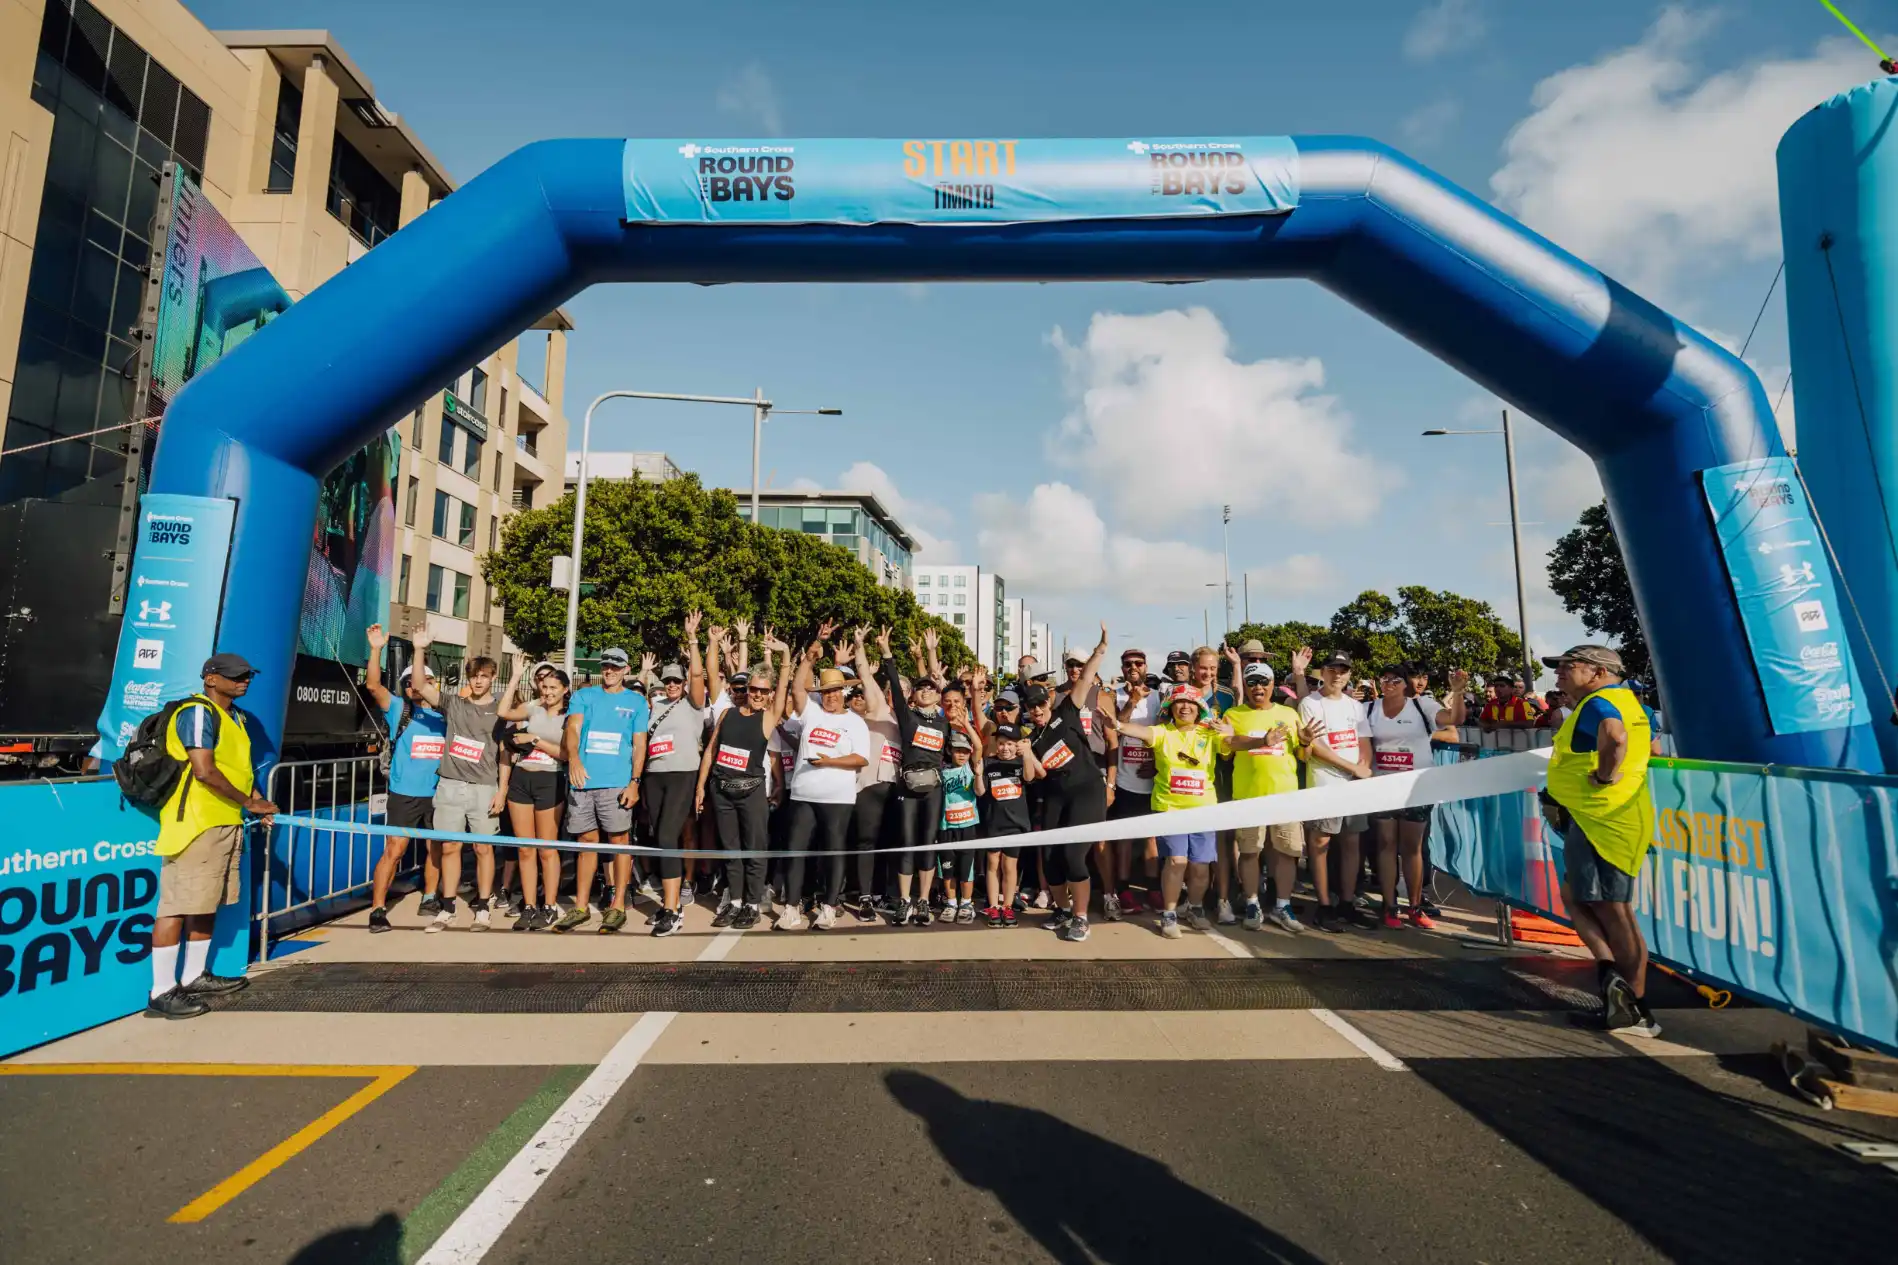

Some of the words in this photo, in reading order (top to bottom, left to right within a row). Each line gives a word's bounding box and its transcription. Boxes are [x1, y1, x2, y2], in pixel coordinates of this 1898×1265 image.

[761, 145, 795, 153] Cross
[903, 140, 1018, 177] START
[700, 156, 794, 174] ROUND
[1150, 152, 1245, 169] ROUND
[711, 176, 795, 201] BAYS
[1162, 169, 1246, 195] BAYS
[457, 406, 487, 432] staircase
[150, 521, 192, 533] ROUND
[152, 531, 190, 546] BAYS
[297, 686, 319, 702] 0800
[320, 688, 336, 704] GET
[336, 690, 350, 705] LED
[93, 838, 157, 862] Cross
[1672, 857, 1775, 957] RUN!
